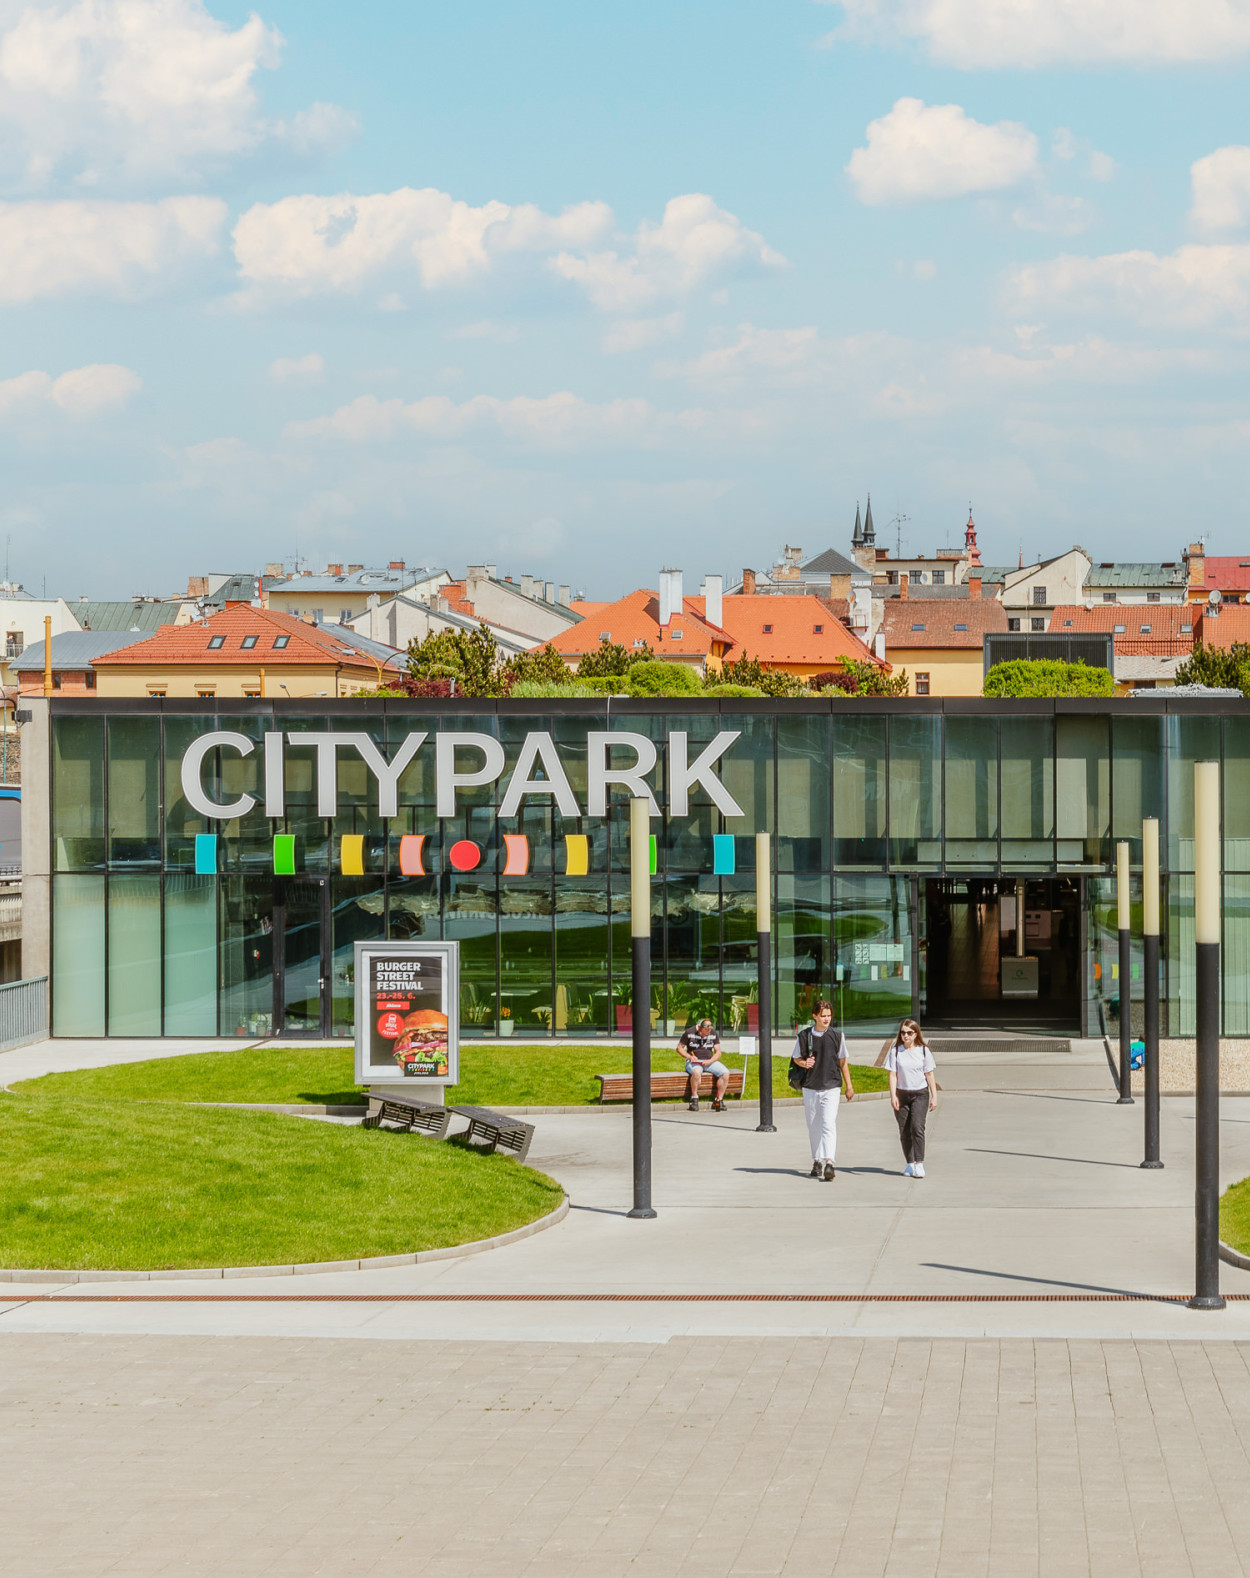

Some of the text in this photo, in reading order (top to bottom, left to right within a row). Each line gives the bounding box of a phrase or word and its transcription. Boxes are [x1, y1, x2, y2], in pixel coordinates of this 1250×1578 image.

[181, 731, 746, 819] CITYPARK
[376, 962, 421, 971] BURGER
[376, 972, 415, 980] STREET
[376, 981, 424, 990] FESTIVAL
